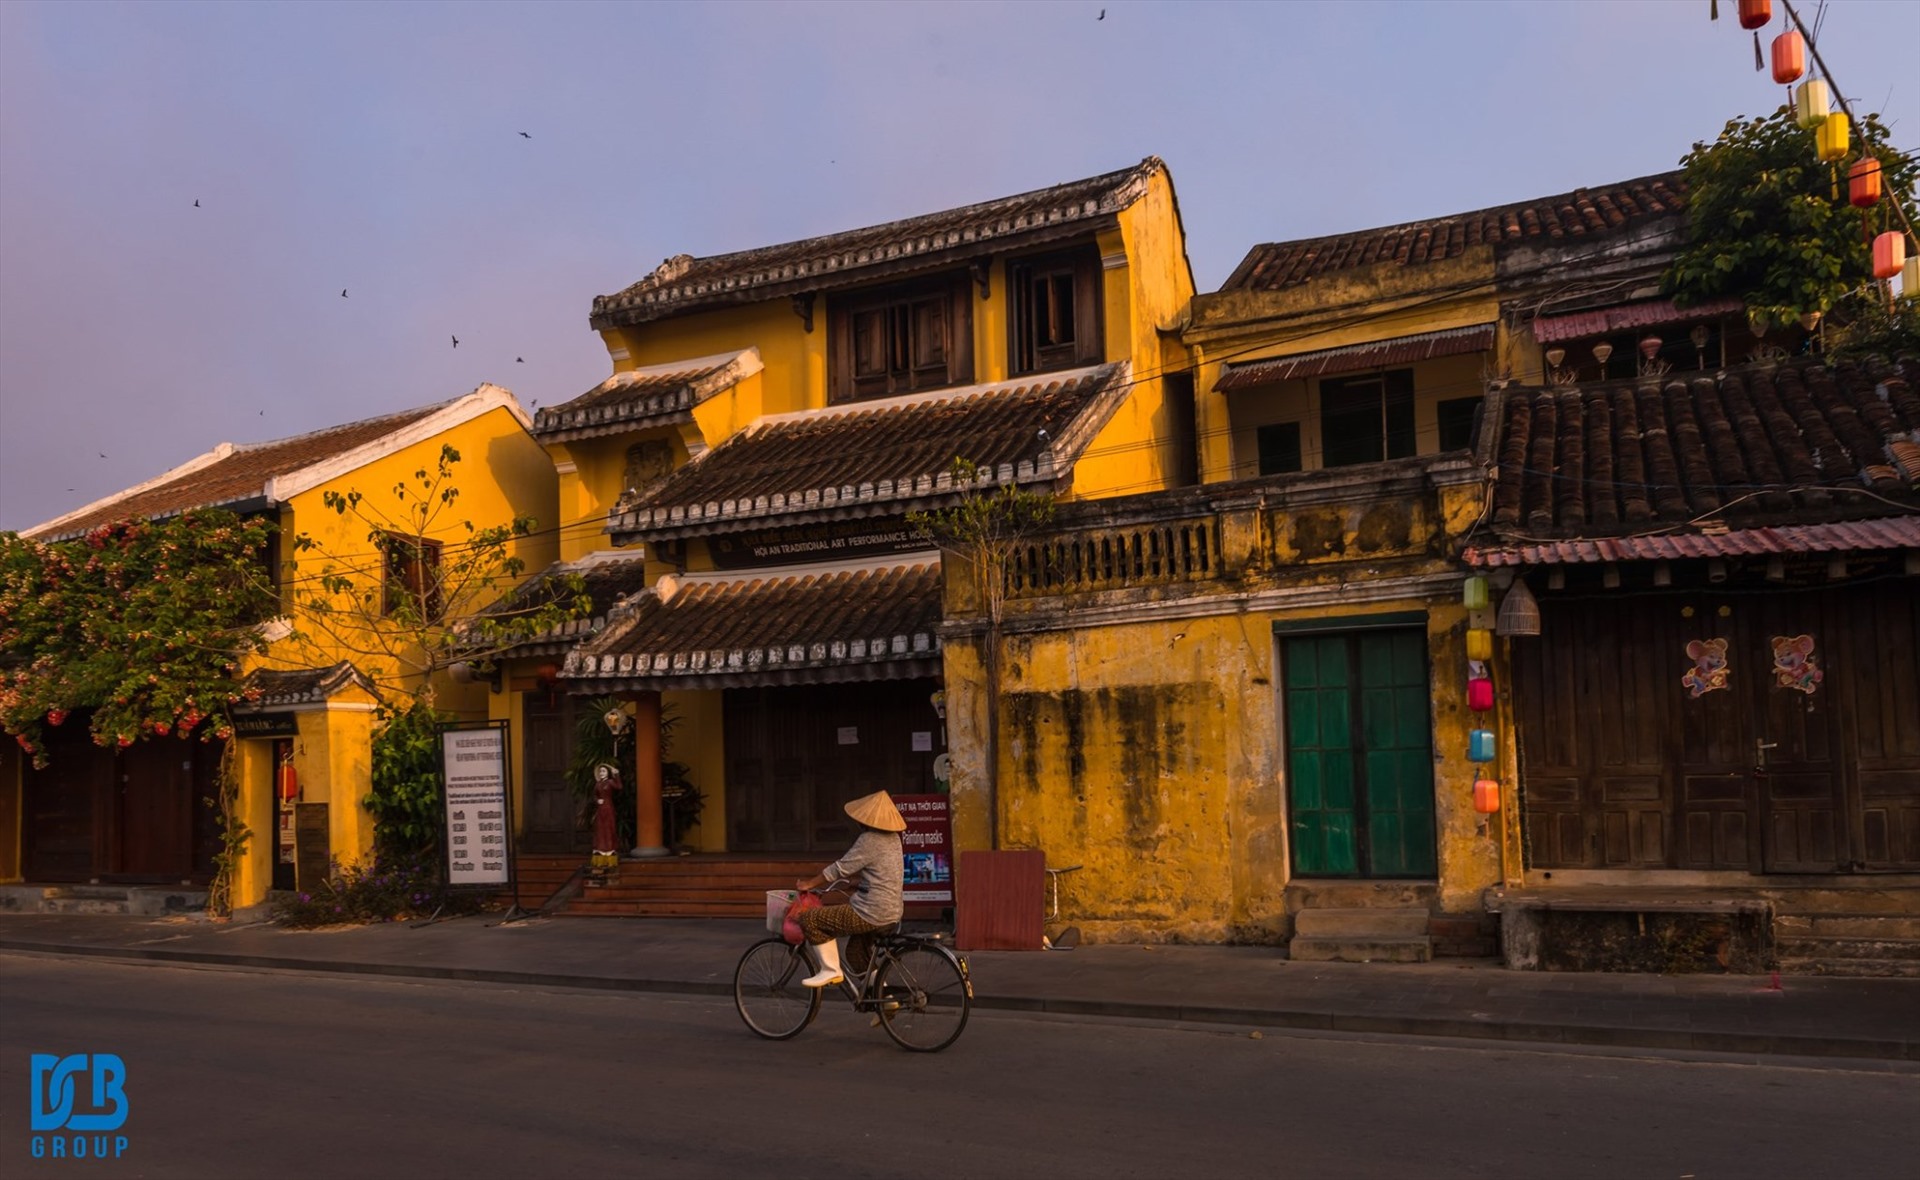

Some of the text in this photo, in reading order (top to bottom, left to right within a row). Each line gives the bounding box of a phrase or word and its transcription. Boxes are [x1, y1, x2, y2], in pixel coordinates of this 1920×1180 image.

[768, 546, 781, 555] AN
[780, 540, 829, 553] TRADITIONAL
[831, 538, 845, 548] ART
[848, 531, 907, 547] PERFORMANCE
[932, 802, 946, 810] GIAN
[902, 830, 944, 848] Painting masks
